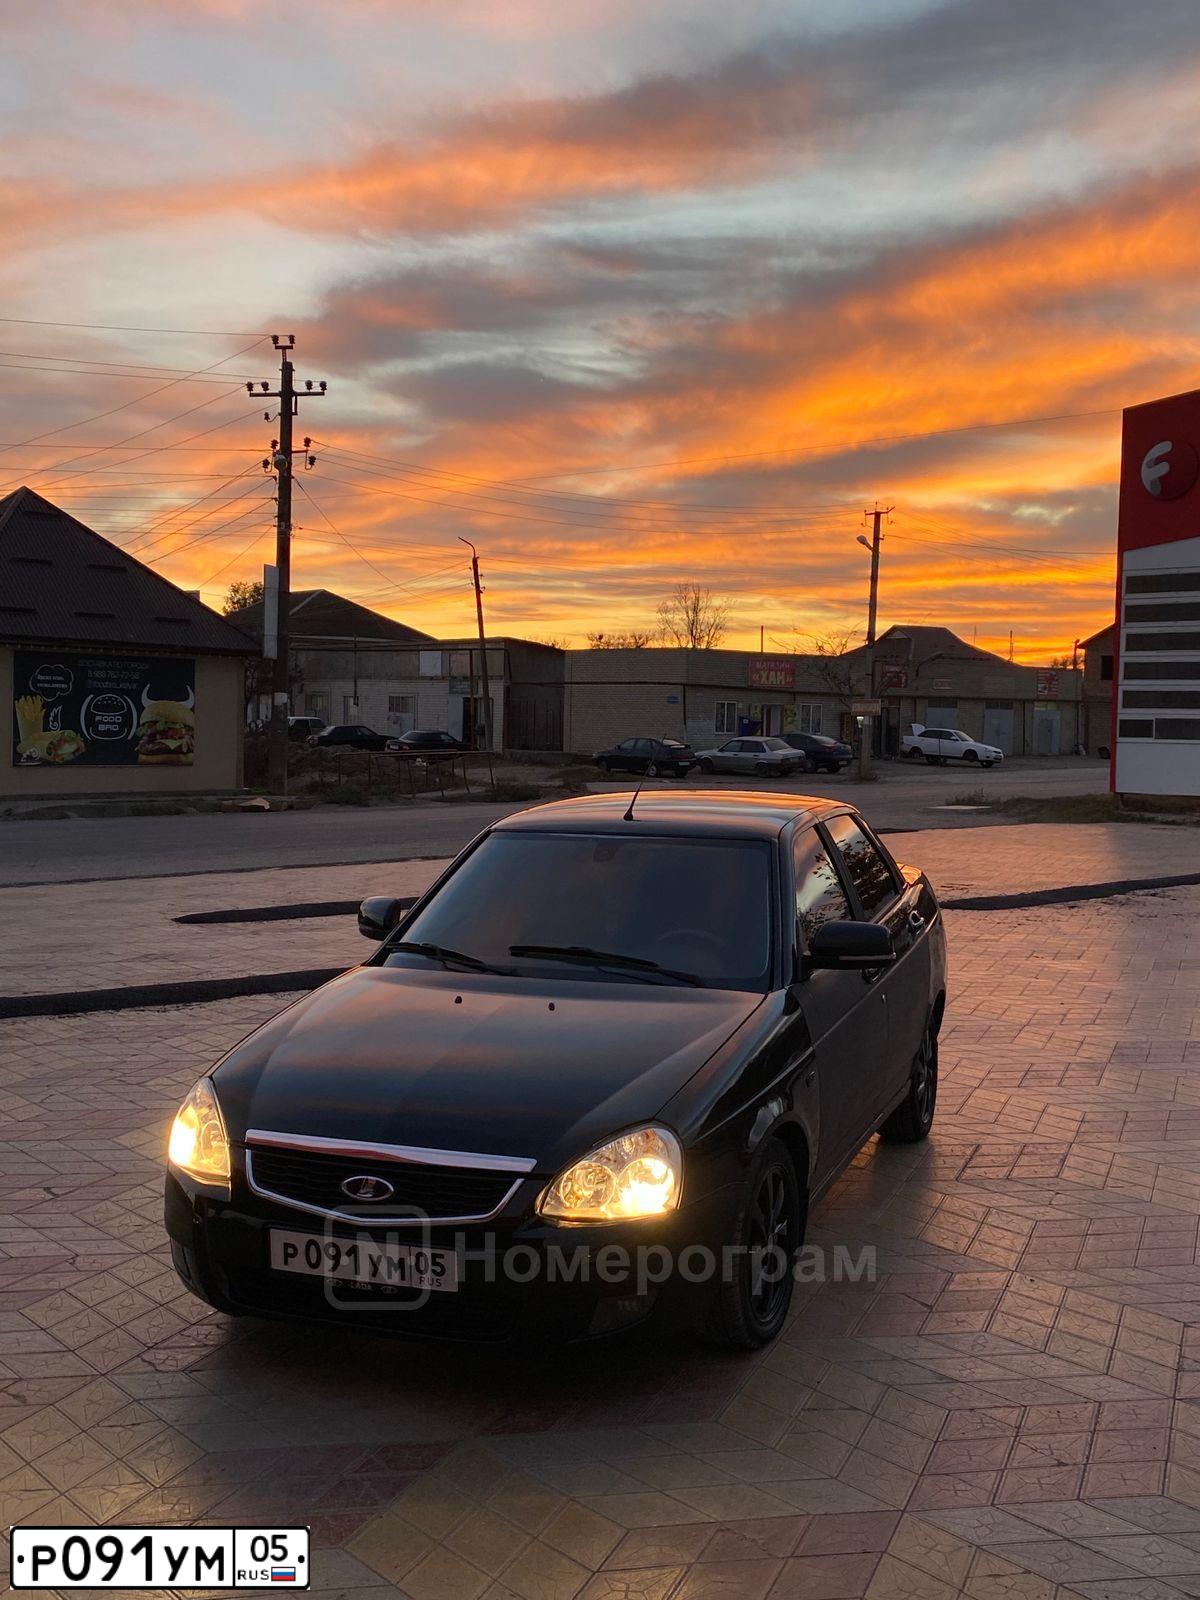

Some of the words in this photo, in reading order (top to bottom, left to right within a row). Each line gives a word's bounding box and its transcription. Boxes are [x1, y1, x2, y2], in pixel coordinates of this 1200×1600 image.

[95, 715, 122, 723] FOOD
[414, 1251, 447, 1278] 05
[418, 1275, 443, 1288] RUS
